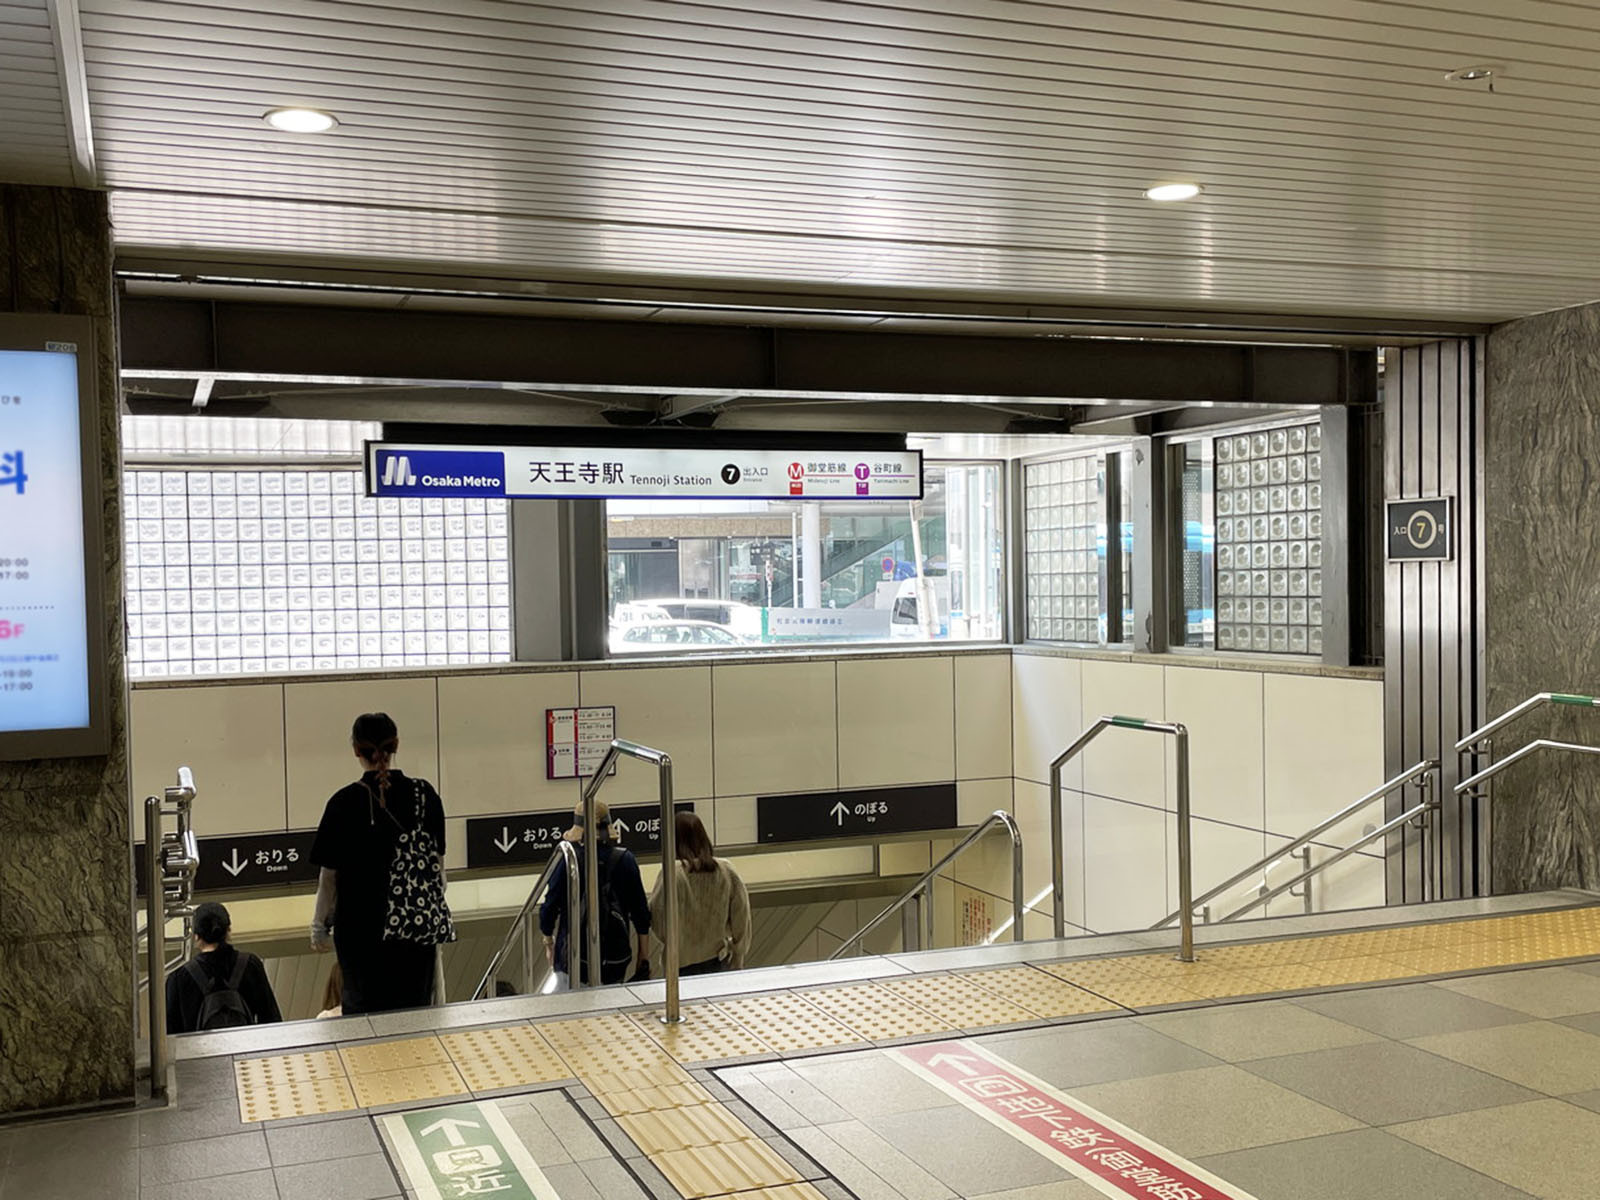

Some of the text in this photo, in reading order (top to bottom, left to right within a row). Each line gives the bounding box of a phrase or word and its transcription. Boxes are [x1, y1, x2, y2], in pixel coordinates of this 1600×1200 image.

[529, 461, 624, 484] 天王寺駅
[726, 467, 736, 481] 7
[743, 466, 768, 476] 出入口
[789, 463, 803, 479] M
[807, 462, 847, 473] 御堂筋線
[856, 465, 868, 479] T
[873, 463, 903, 474] 谷町線
[421, 475, 501, 487] Osaka Metro
[630, 475, 712, 487] Tennoji Station
[1393, 525, 1407, 535] 入口
[1416, 522, 1427, 539] 7
[854, 801, 888, 815] のぼる
[635, 818, 661, 832] のぼ
[523, 826, 562, 843] おりる
[533, 842, 553, 850] Down
[255, 848, 299, 865] おりる
[266, 864, 288, 873] Down
[451, 1169, 512, 1196] 近
